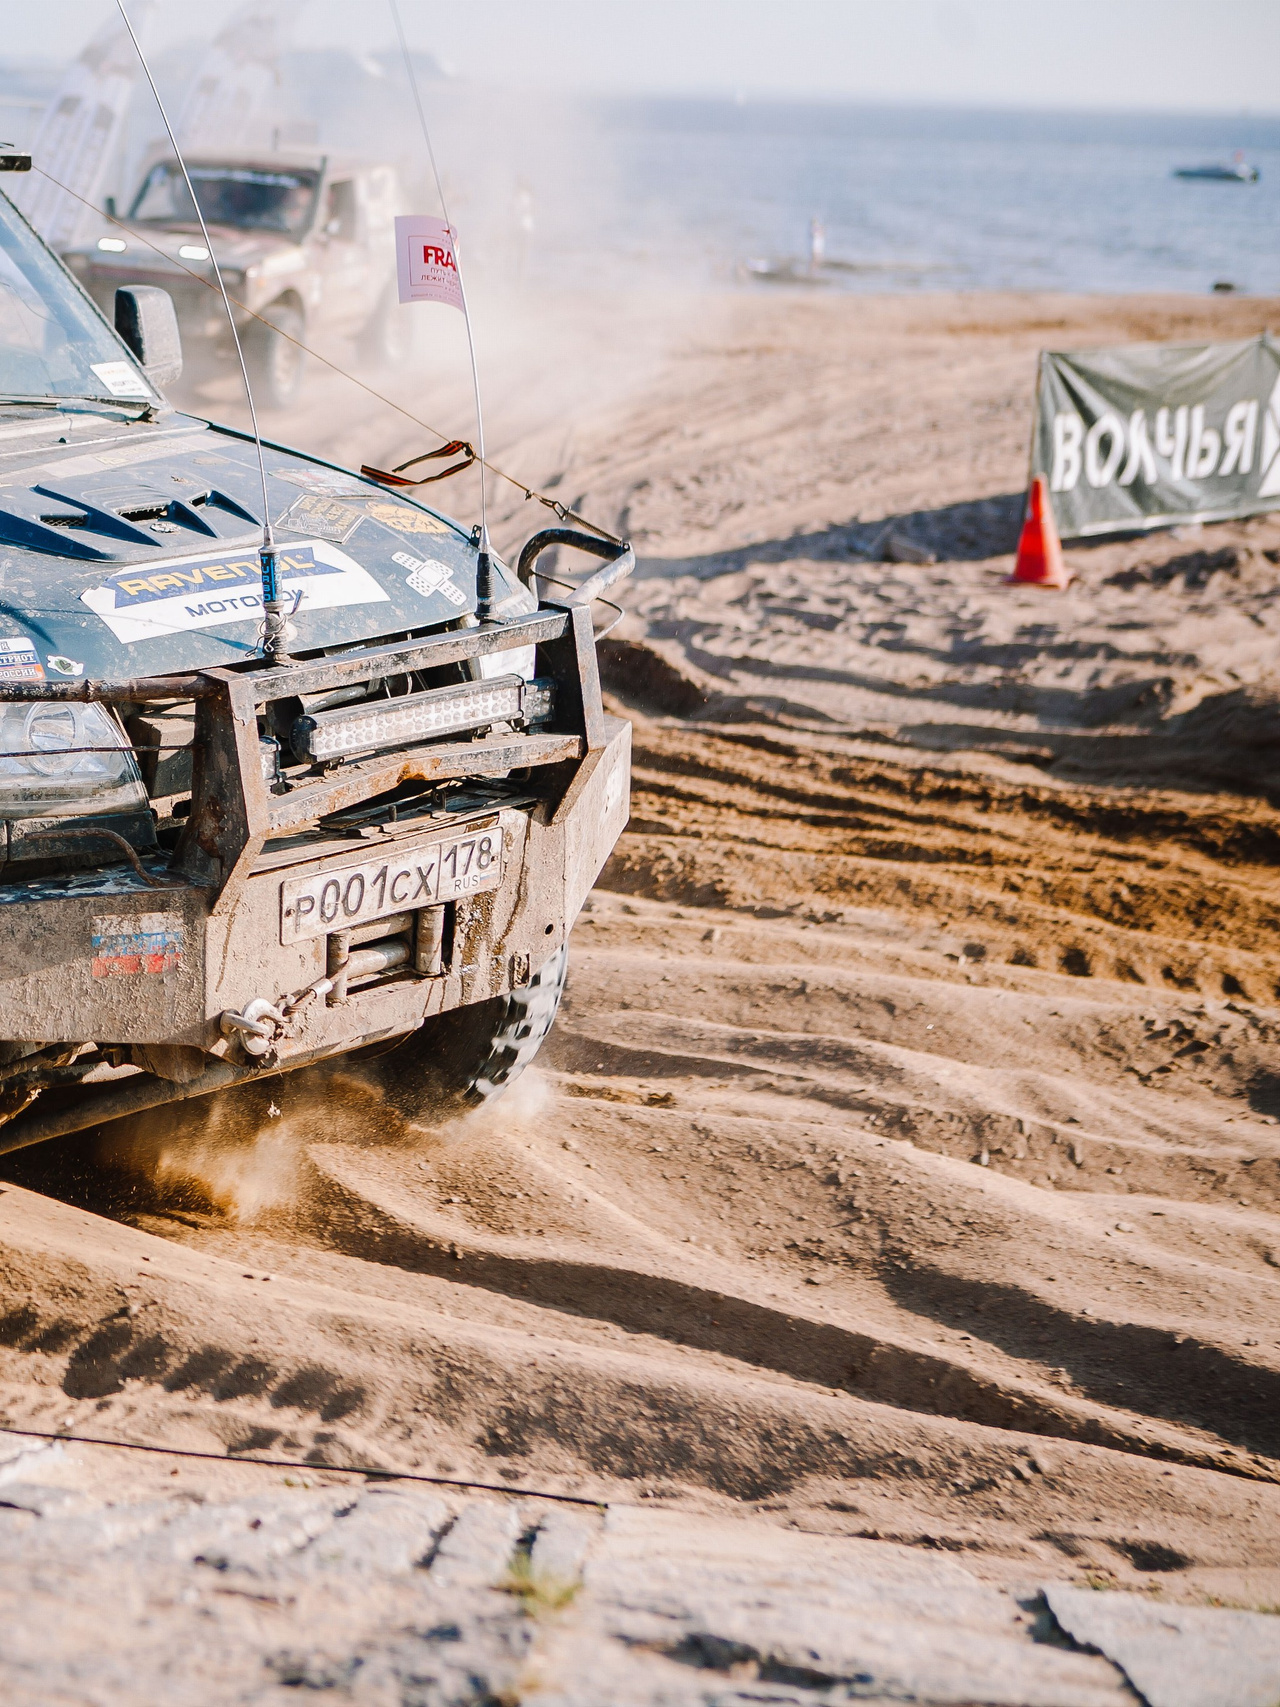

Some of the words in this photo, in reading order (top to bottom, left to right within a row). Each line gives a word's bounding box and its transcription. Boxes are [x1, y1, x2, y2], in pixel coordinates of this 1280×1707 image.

[1049, 398, 1260, 493] ВОЛЧЬЯ
[262, 556, 272, 601] TURBO
[443, 836, 494, 879] 178
[454, 874, 481, 893] RUS
